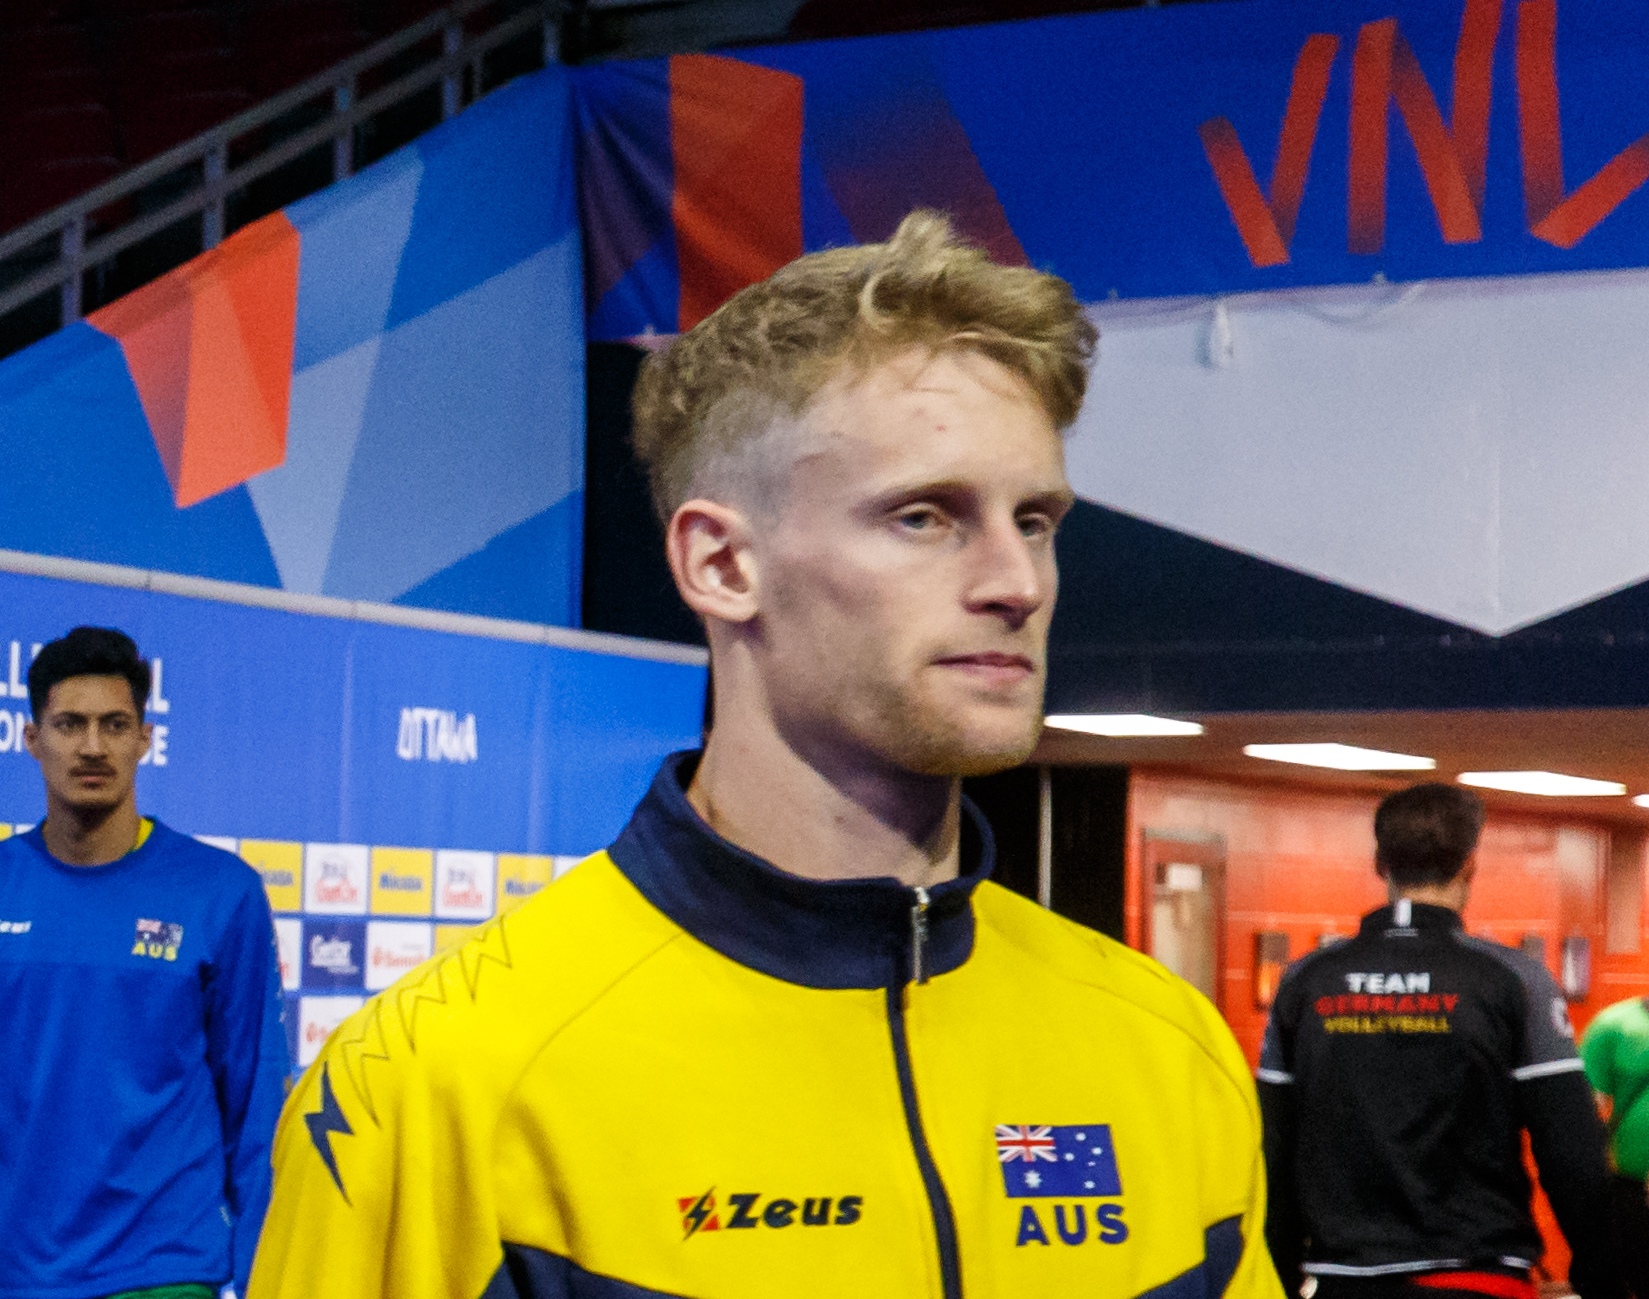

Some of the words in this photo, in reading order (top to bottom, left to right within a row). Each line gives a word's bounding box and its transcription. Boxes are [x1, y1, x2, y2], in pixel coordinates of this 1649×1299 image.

[1197, 0, 1649, 268] VNL
[131, 941, 178, 962] AUS
[1345, 972, 1431, 994] TEAM
[726, 1194, 863, 1228] Zeus
[1015, 1203, 1130, 1247] AUS
